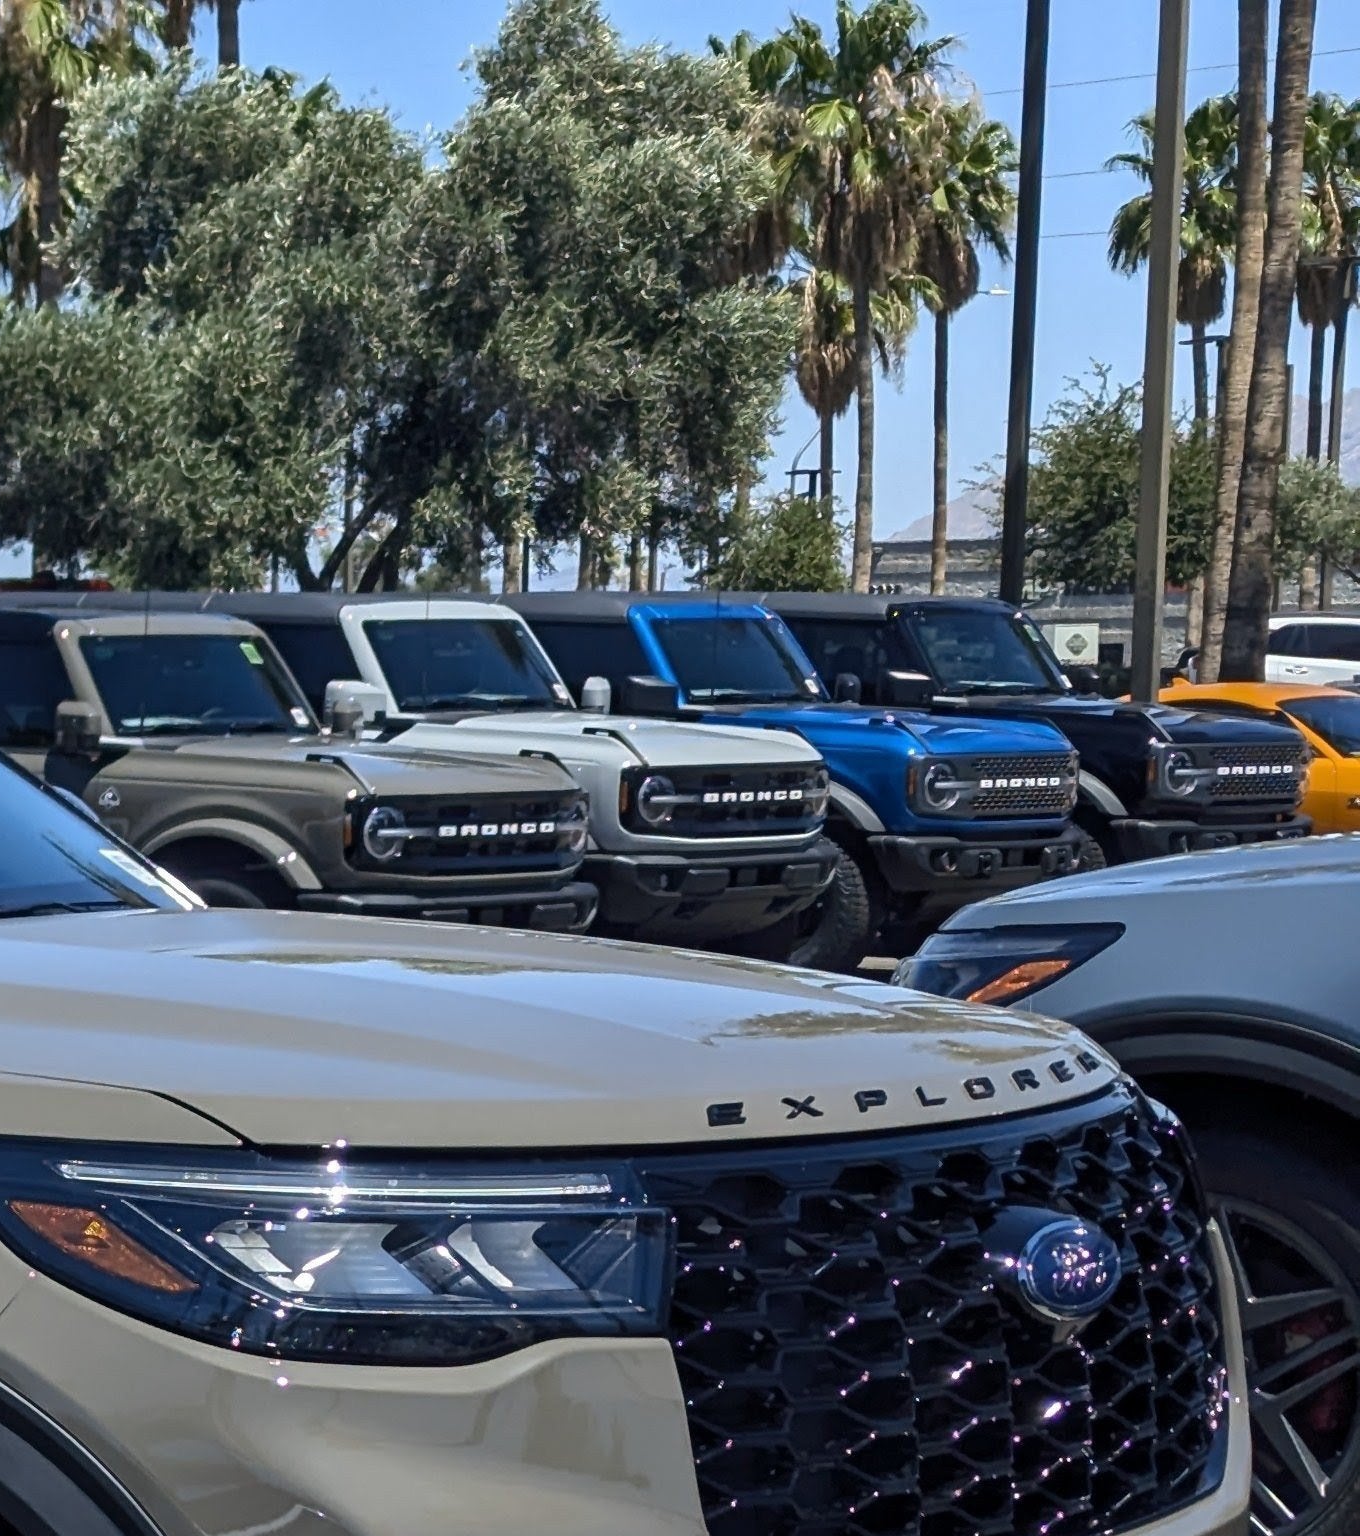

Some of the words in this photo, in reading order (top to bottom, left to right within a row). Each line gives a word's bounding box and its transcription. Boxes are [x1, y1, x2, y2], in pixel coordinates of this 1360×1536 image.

[1216, 764, 1294, 776] BRONCO
[979, 776, 1061, 789] BRONCO
[702, 789, 803, 803] BRONCO
[437, 821, 556, 838] BRONCO
[706, 1051, 1104, 1128] EXPLORER
